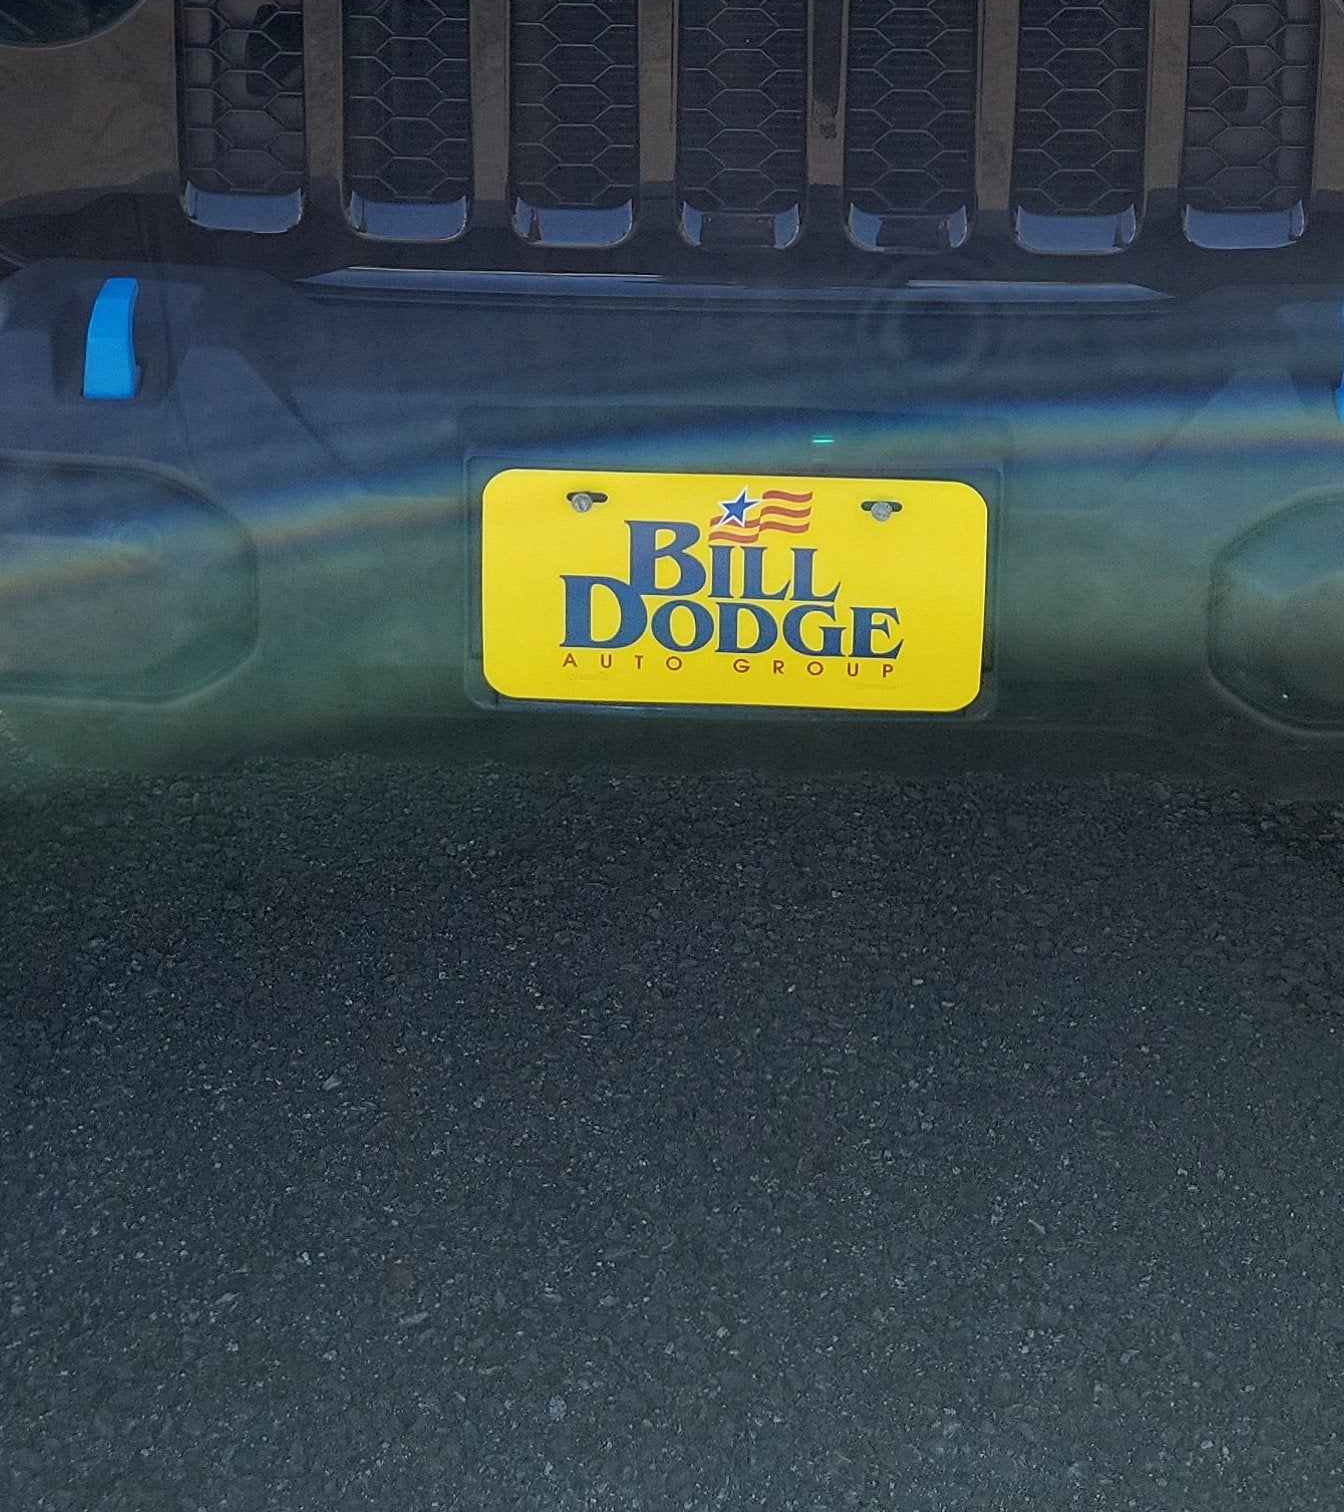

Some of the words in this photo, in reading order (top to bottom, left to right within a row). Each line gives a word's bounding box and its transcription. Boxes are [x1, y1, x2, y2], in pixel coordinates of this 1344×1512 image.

[624, 519, 842, 603] BILL
[559, 574, 905, 660] DODGE
[562, 652, 684, 671] AUTO
[732, 657, 895, 678] GROUP
